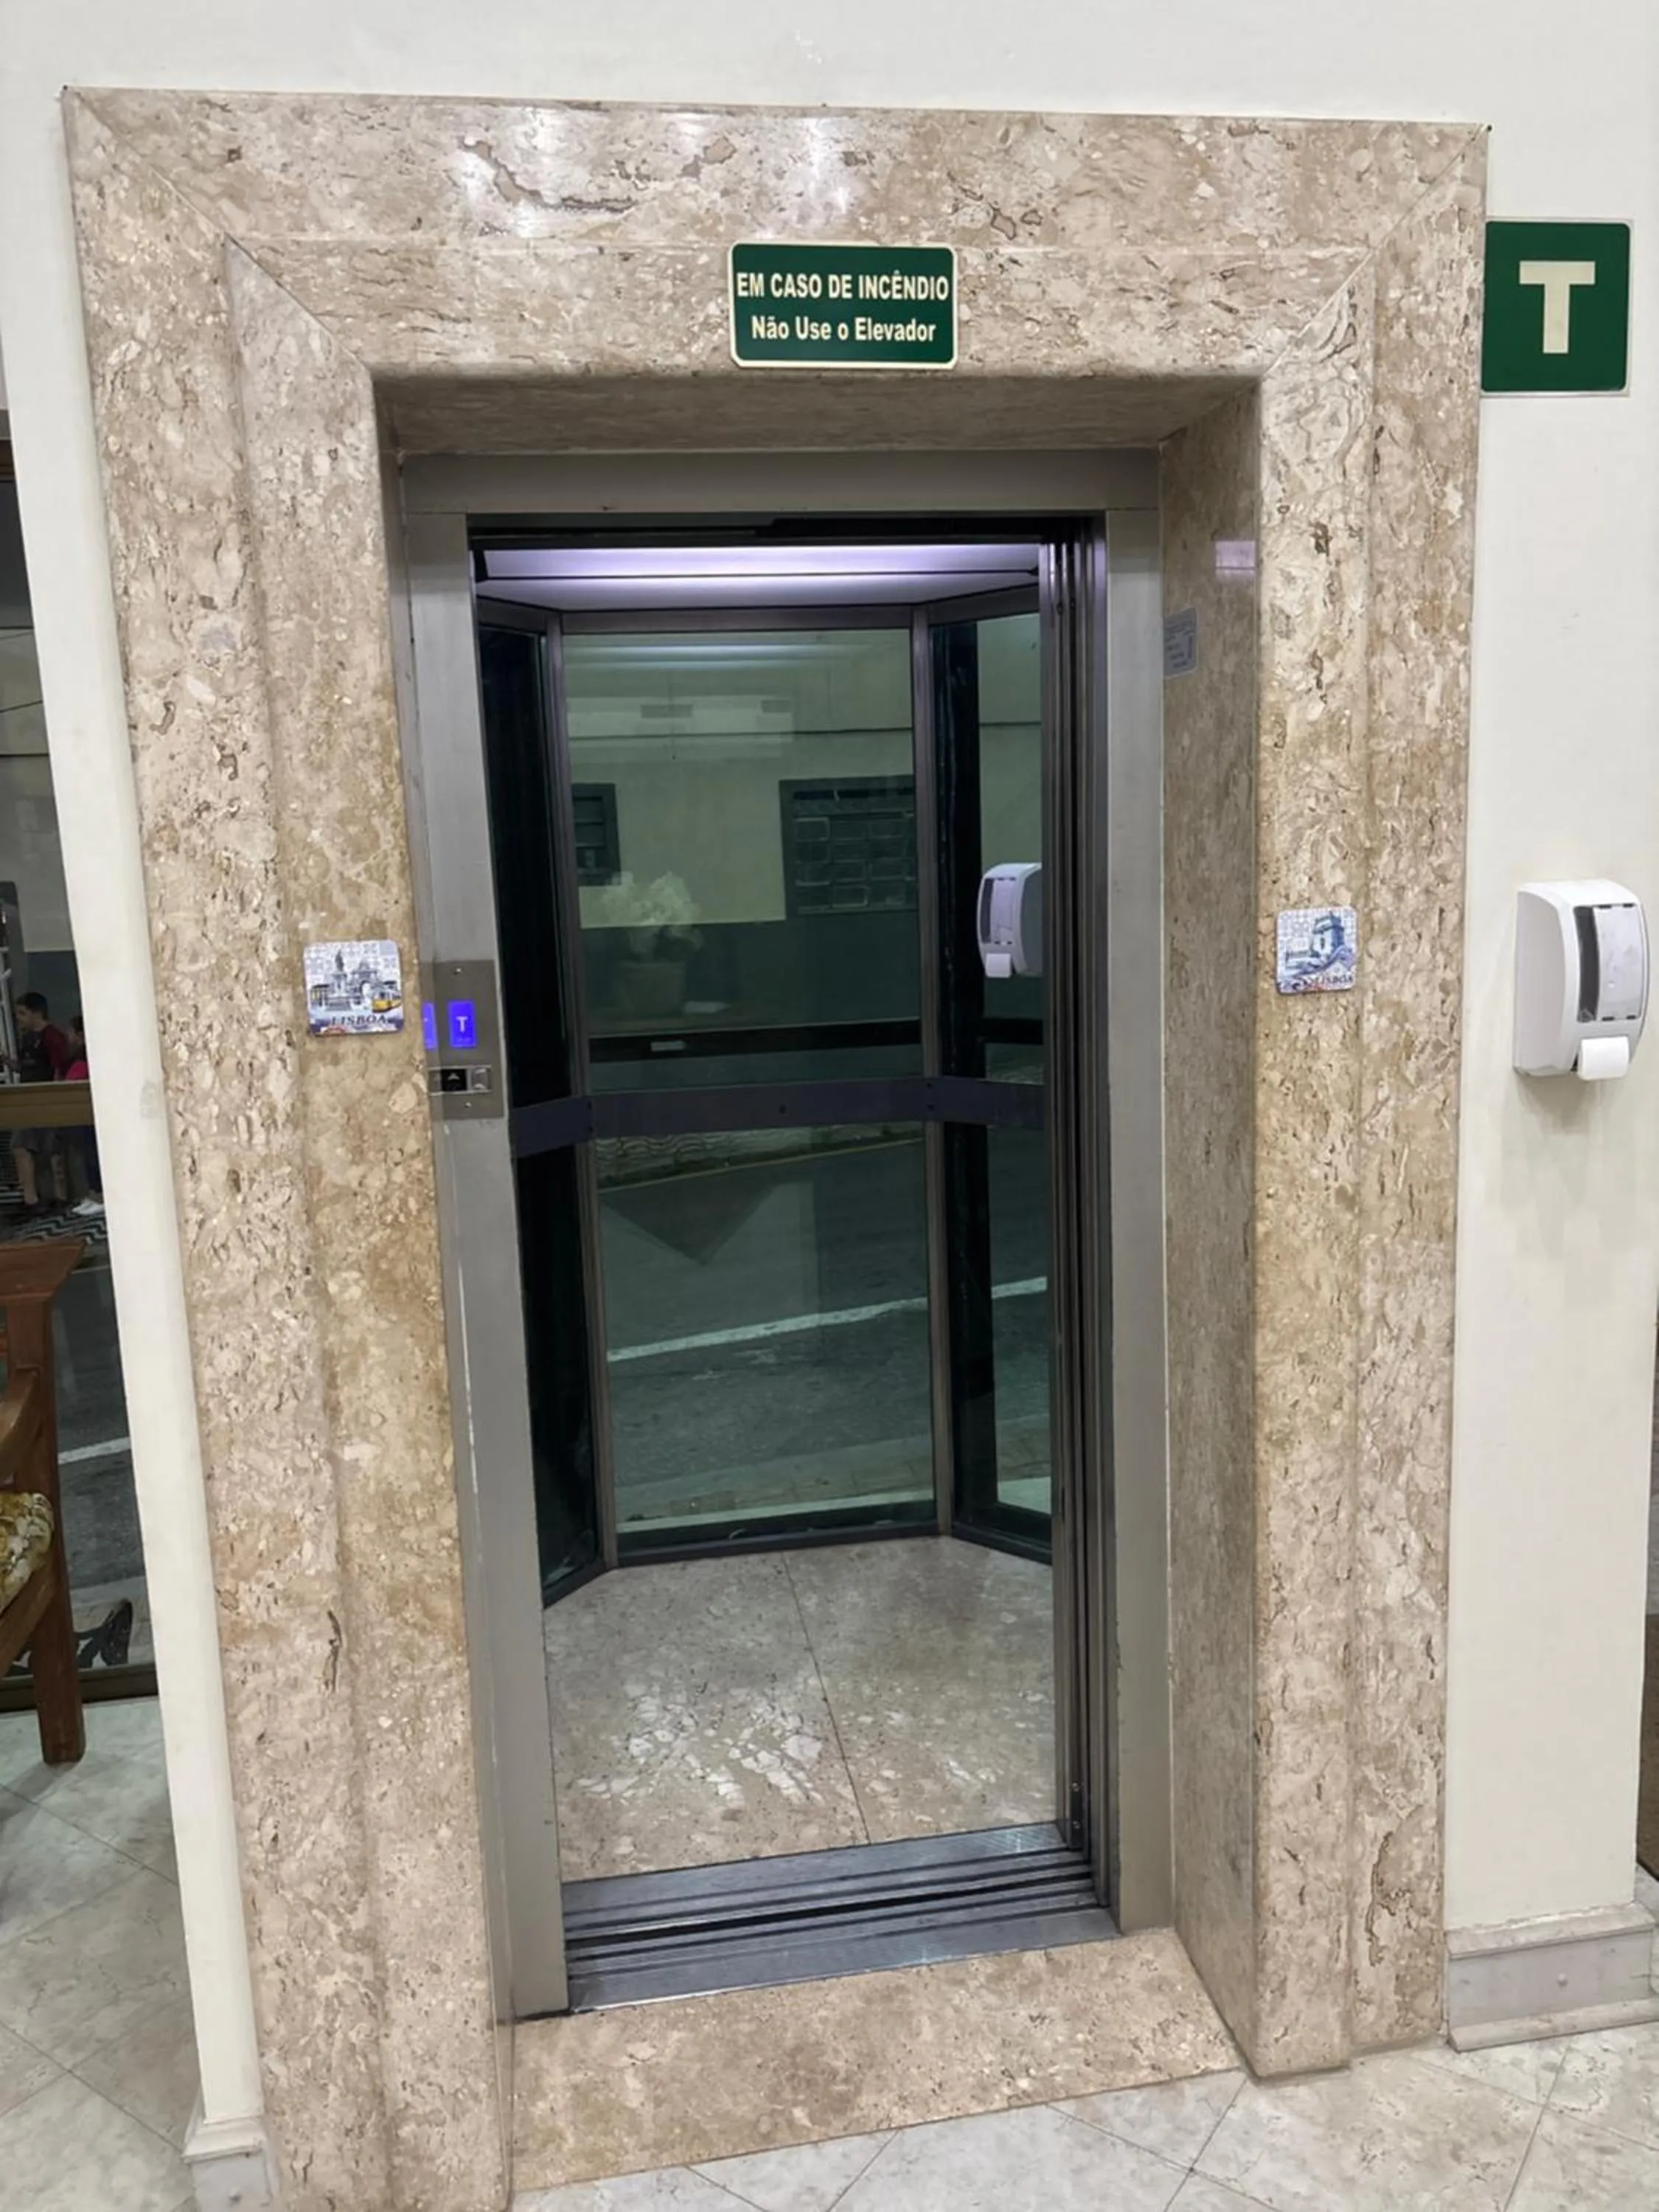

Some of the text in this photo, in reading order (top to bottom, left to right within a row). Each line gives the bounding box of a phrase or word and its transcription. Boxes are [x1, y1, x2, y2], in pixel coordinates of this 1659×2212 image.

[737, 269, 949, 301] EM CASO DE INCÊNDIO
[1520, 260, 1596, 354] T
[751, 316, 936, 342] Não Use o Elevador
[456, 1016, 468, 1032] T
